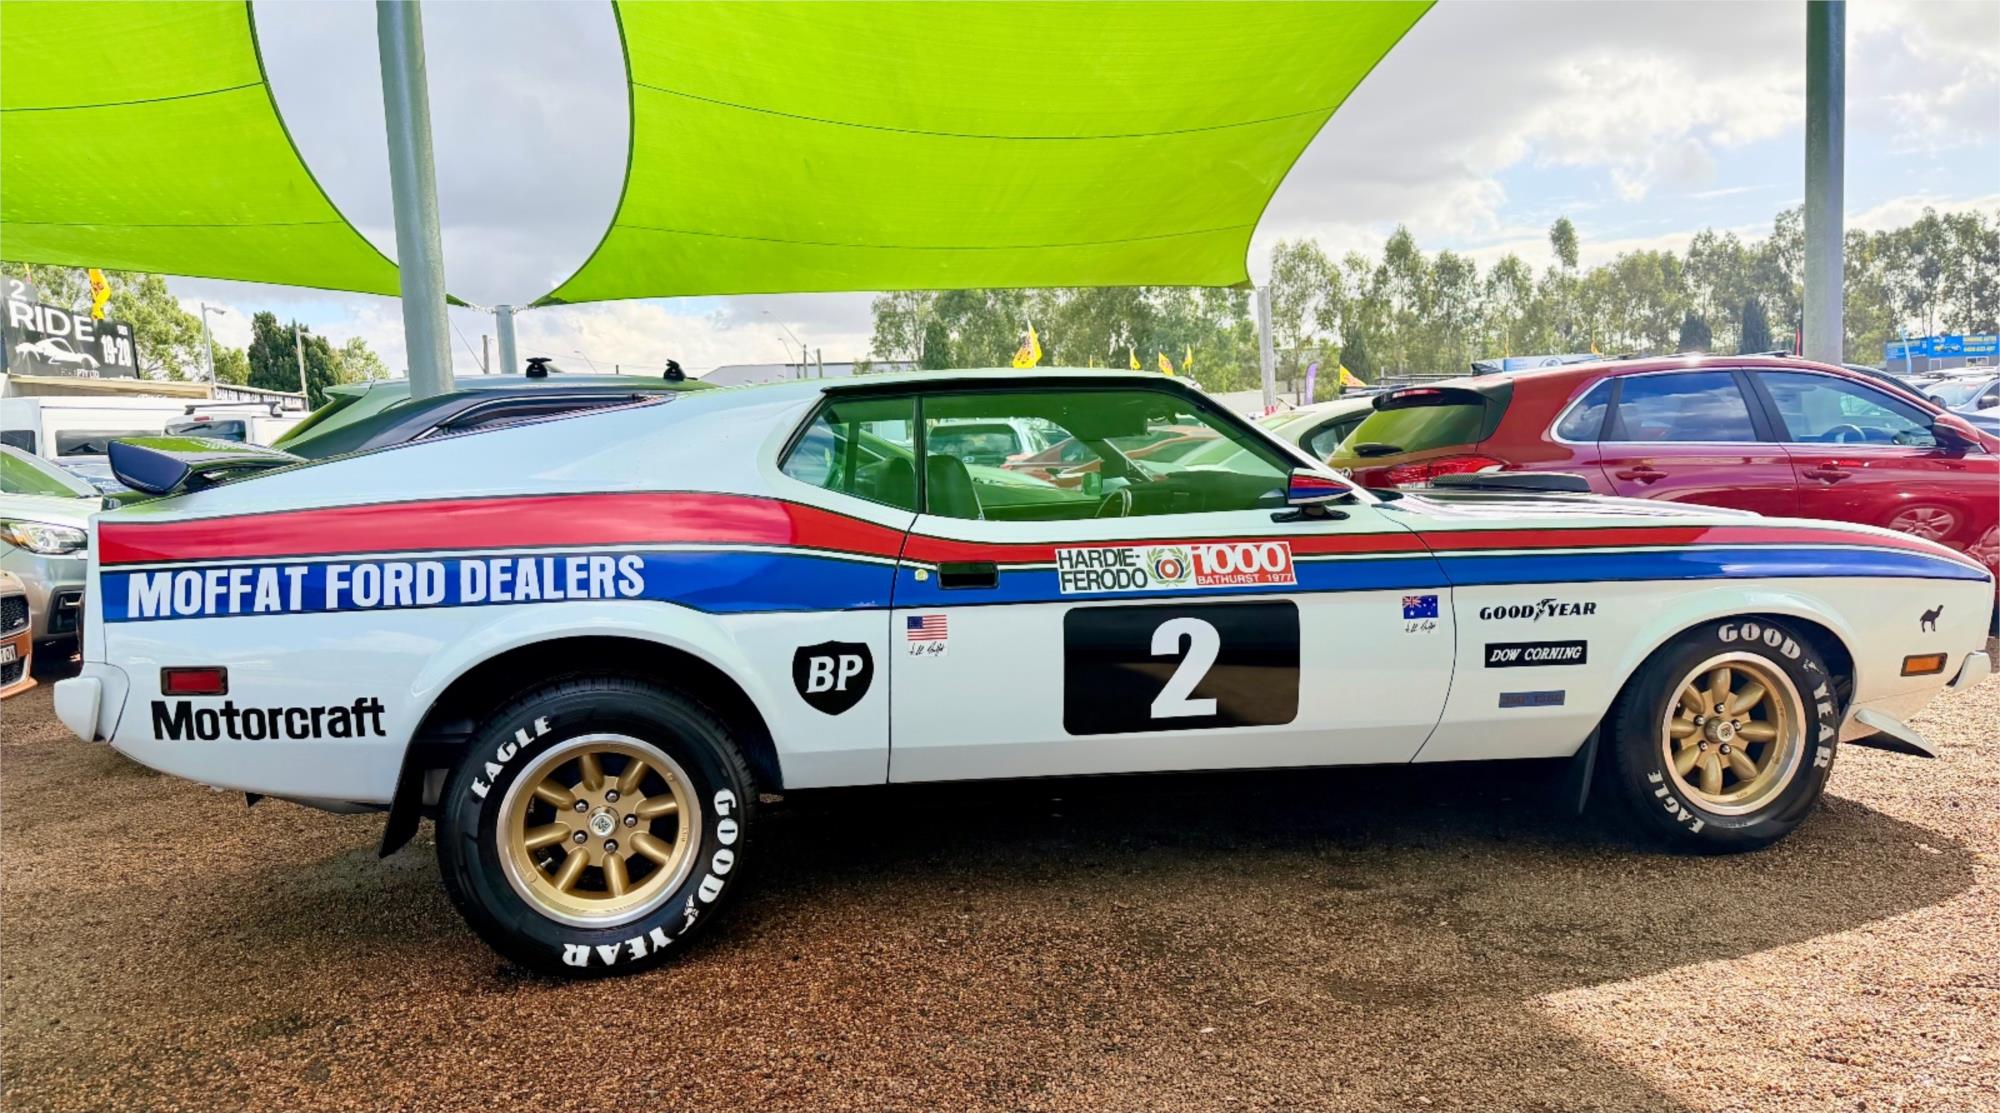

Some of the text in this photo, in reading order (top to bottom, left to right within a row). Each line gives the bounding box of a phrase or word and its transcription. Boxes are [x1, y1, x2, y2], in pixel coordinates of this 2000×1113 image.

[9, 279, 27, 300] 2
[9, 300, 96, 342] RIDE
[1061, 568, 1148, 591] FERODO
[1191, 544, 1286, 575] 1000
[1198, 573, 1291, 585] BATHURST 1977
[128, 554, 645, 618] MOFFAT FORD DEALERS
[806, 654, 863, 693] BP
[1150, 617, 1220, 718] 2
[1490, 646, 1583, 662] DOW CORNING
[151, 697, 386, 740] Motorcraft
[471, 715, 552, 799] EAGLE
[1648, 770, 1705, 833] EAGLE
